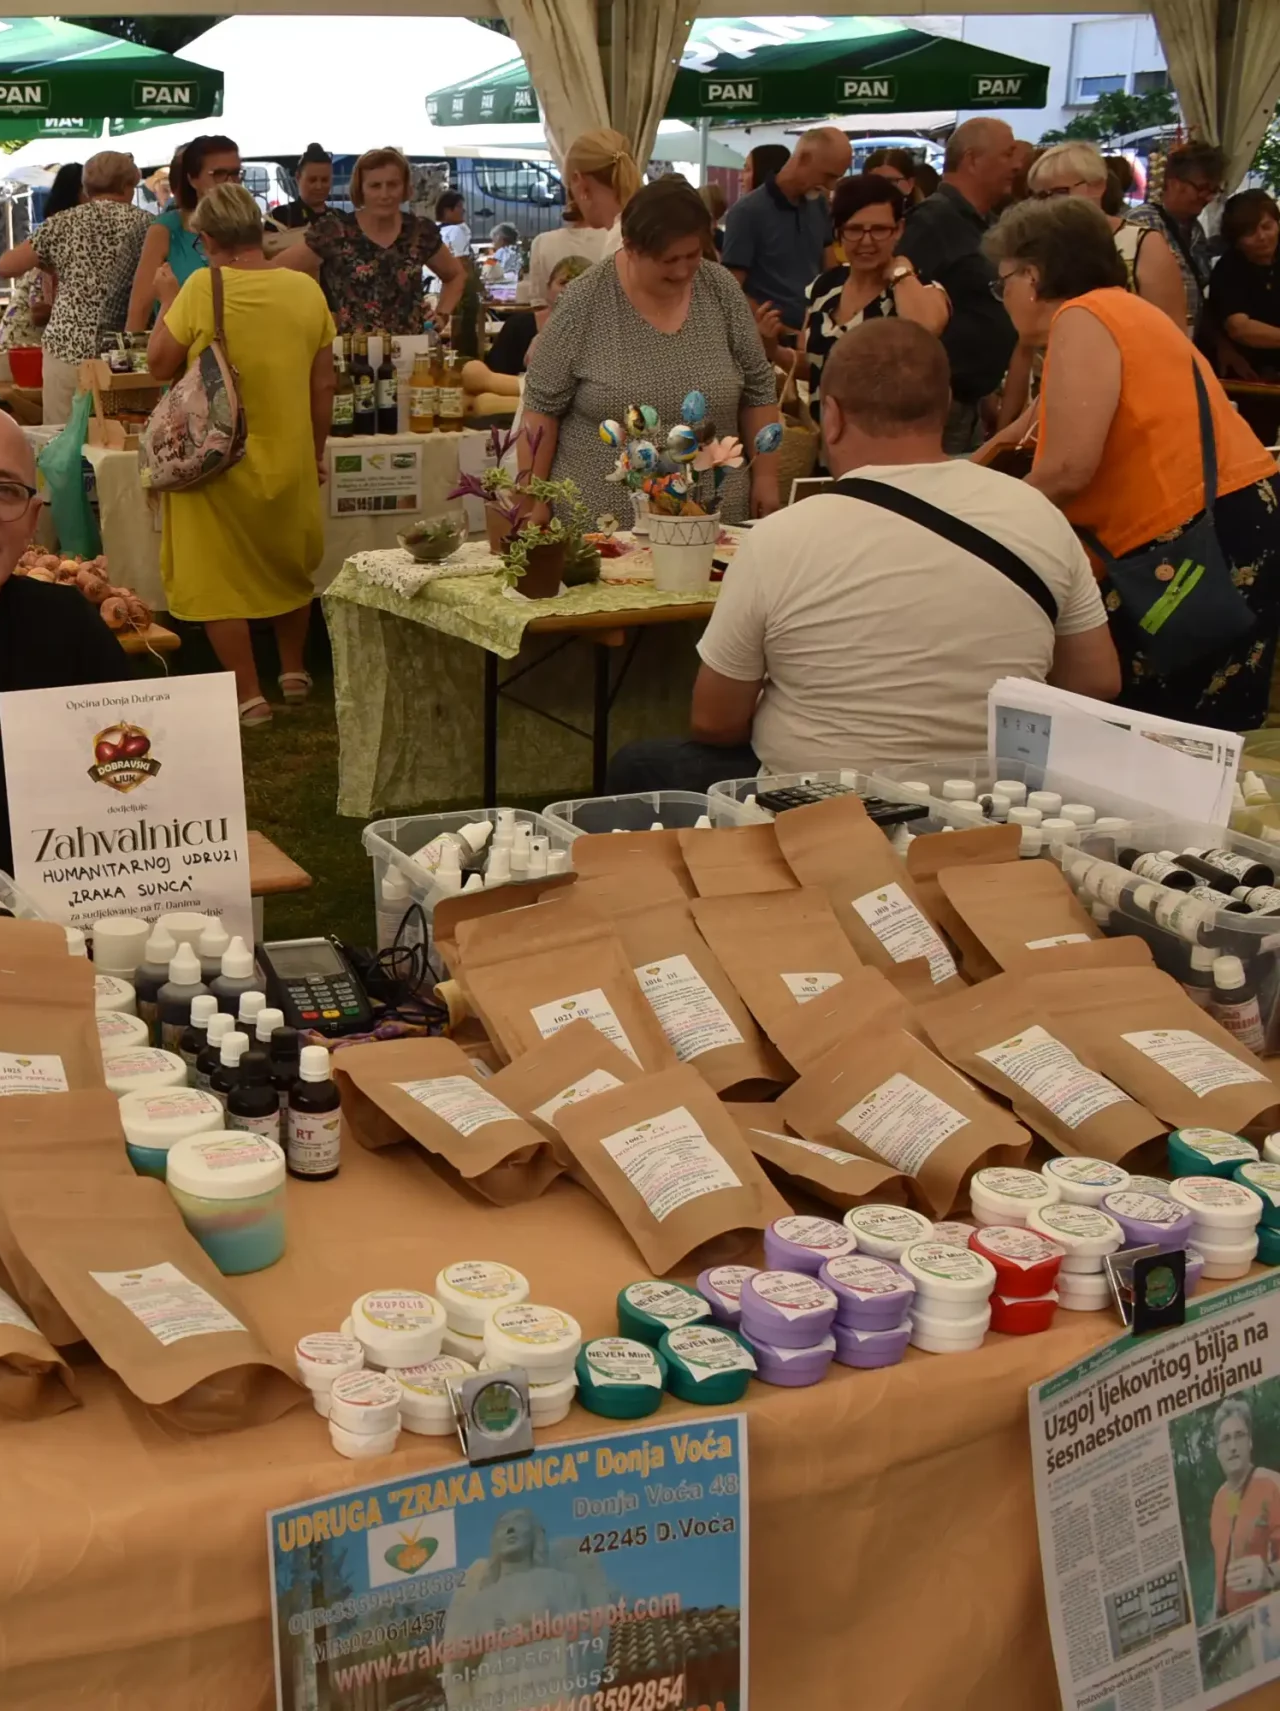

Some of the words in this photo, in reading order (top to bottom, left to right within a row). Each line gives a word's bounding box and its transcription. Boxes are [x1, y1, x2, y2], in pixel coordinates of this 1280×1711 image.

[142, 86, 190, 103] PAN
[708, 83, 753, 100] PAN
[844, 81, 889, 97] PAN
[978, 79, 1020, 95] PAN
[66, 699, 100, 711] Općina
[102, 696, 130, 708] Donja
[131, 692, 170, 705] Dubrava
[97, 760, 150, 777] DOBRAVSKI
[107, 803, 148, 816] dodjeljuje
[31, 818, 229, 863] Zahvalnicu
[43, 857, 171, 884] HUMANITARNOJ
[82, 904, 138, 920] sudjelovanje
[140, 905, 151, 913] na
[165, 898, 201, 910] Danima
[295, 1128, 314, 1140] RT
[857, 1216, 888, 1226] OLIVA
[914, 1253, 947, 1263] OLIVA
[451, 1273, 487, 1284] NEVEN
[833, 1268, 862, 1279] NEVEN
[712, 1278, 742, 1287] NEVEN
[759, 1284, 788, 1297] NEVEN
[370, 1300, 424, 1309] PROPOLIS
[633, 1293, 662, 1308] NEVEN
[663, 1286, 680, 1298] Mint
[501, 1317, 539, 1328] NEVEN
[672, 1340, 707, 1352] NEVEN
[707, 1335, 730, 1346] Mint
[588, 1351, 627, 1360] NEVEN
[628, 1351, 651, 1360] Mint
[401, 1361, 454, 1377] PROPOLIS
[1043, 1394, 1094, 1442] Uzgoj
[1098, 1352, 1191, 1416] ljekovitog
[1195, 1329, 1239, 1367] bilja
[1244, 1321, 1269, 1345] na
[1046, 1404, 1152, 1474] šesnaestom
[1158, 1356, 1263, 1417] meridijanu
[277, 1497, 384, 1552] UDRUGA
[388, 1471, 486, 1520] "ZRAKA
[491, 1451, 589, 1498] SUNCA"
[596, 1440, 664, 1478] Donja
[671, 1429, 732, 1464] Voća
[574, 1491, 639, 1519] Donja
[644, 1480, 703, 1507] Voća
[709, 1473, 739, 1496] 48
[578, 1525, 648, 1554] 42245
[334, 1592, 681, 1692] www.zrakasunca.blogspot.com
